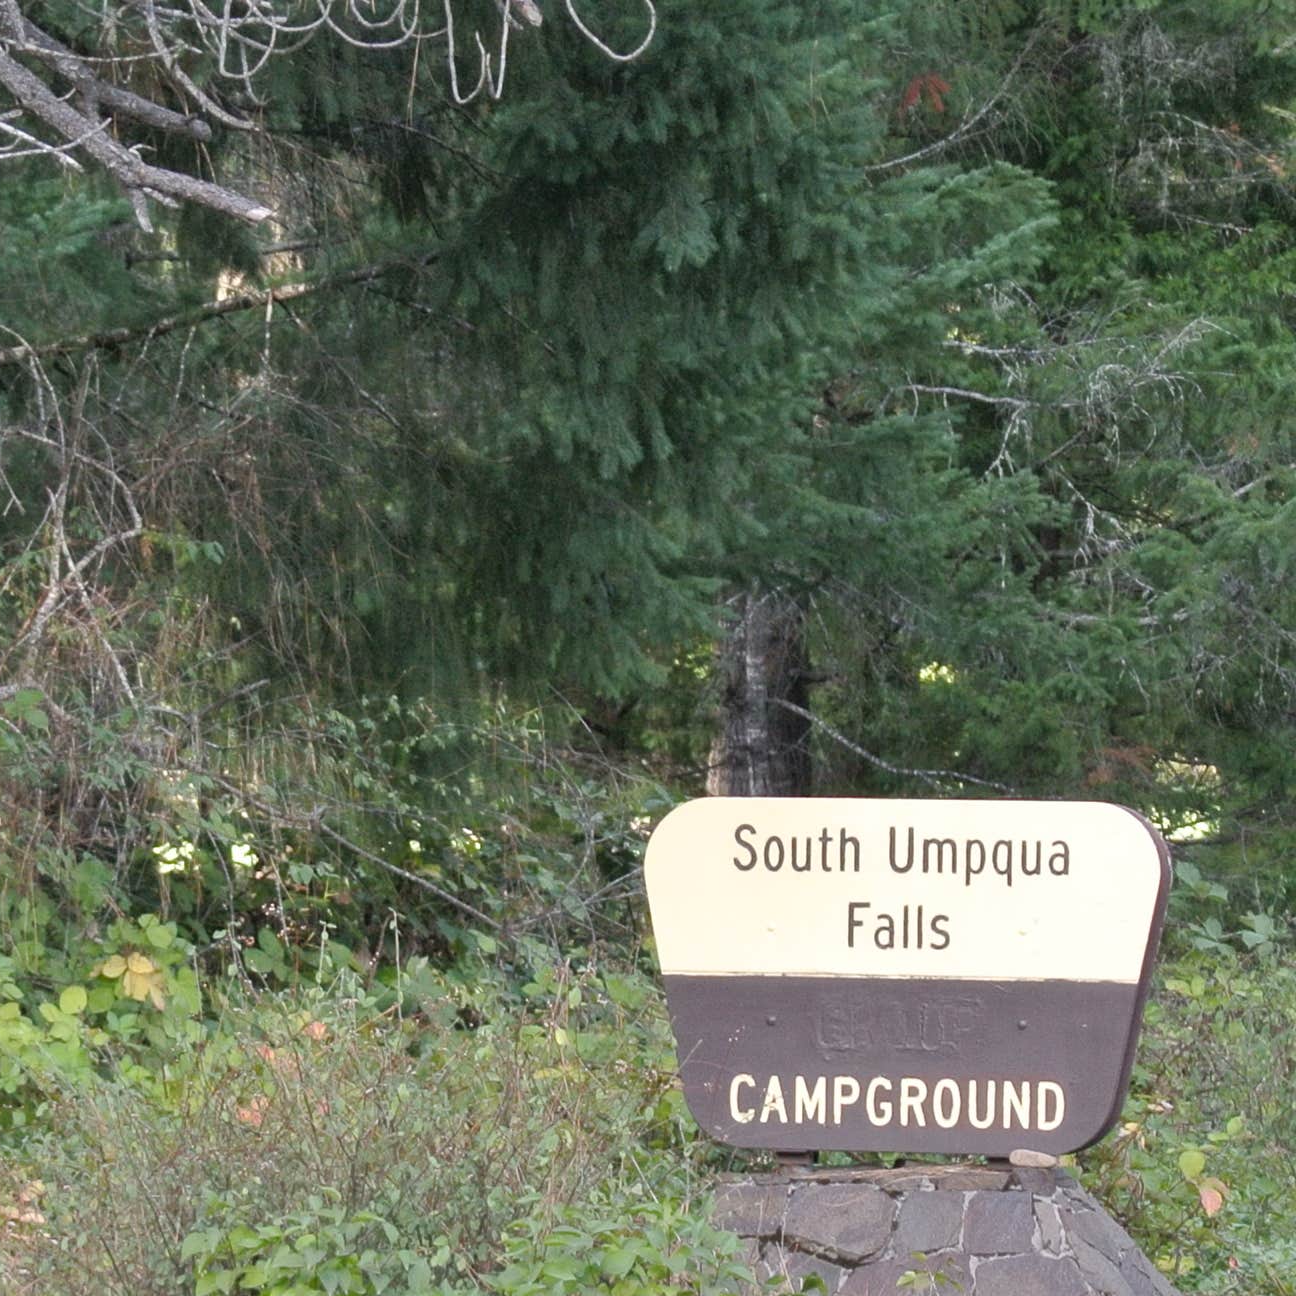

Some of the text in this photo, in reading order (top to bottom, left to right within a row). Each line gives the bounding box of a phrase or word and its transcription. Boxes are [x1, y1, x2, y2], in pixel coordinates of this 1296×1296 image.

[732, 823, 1071, 887] South Umpqua
[846, 902, 952, 951] Falls
[729, 1073, 1066, 1132] CAMPGROUND
